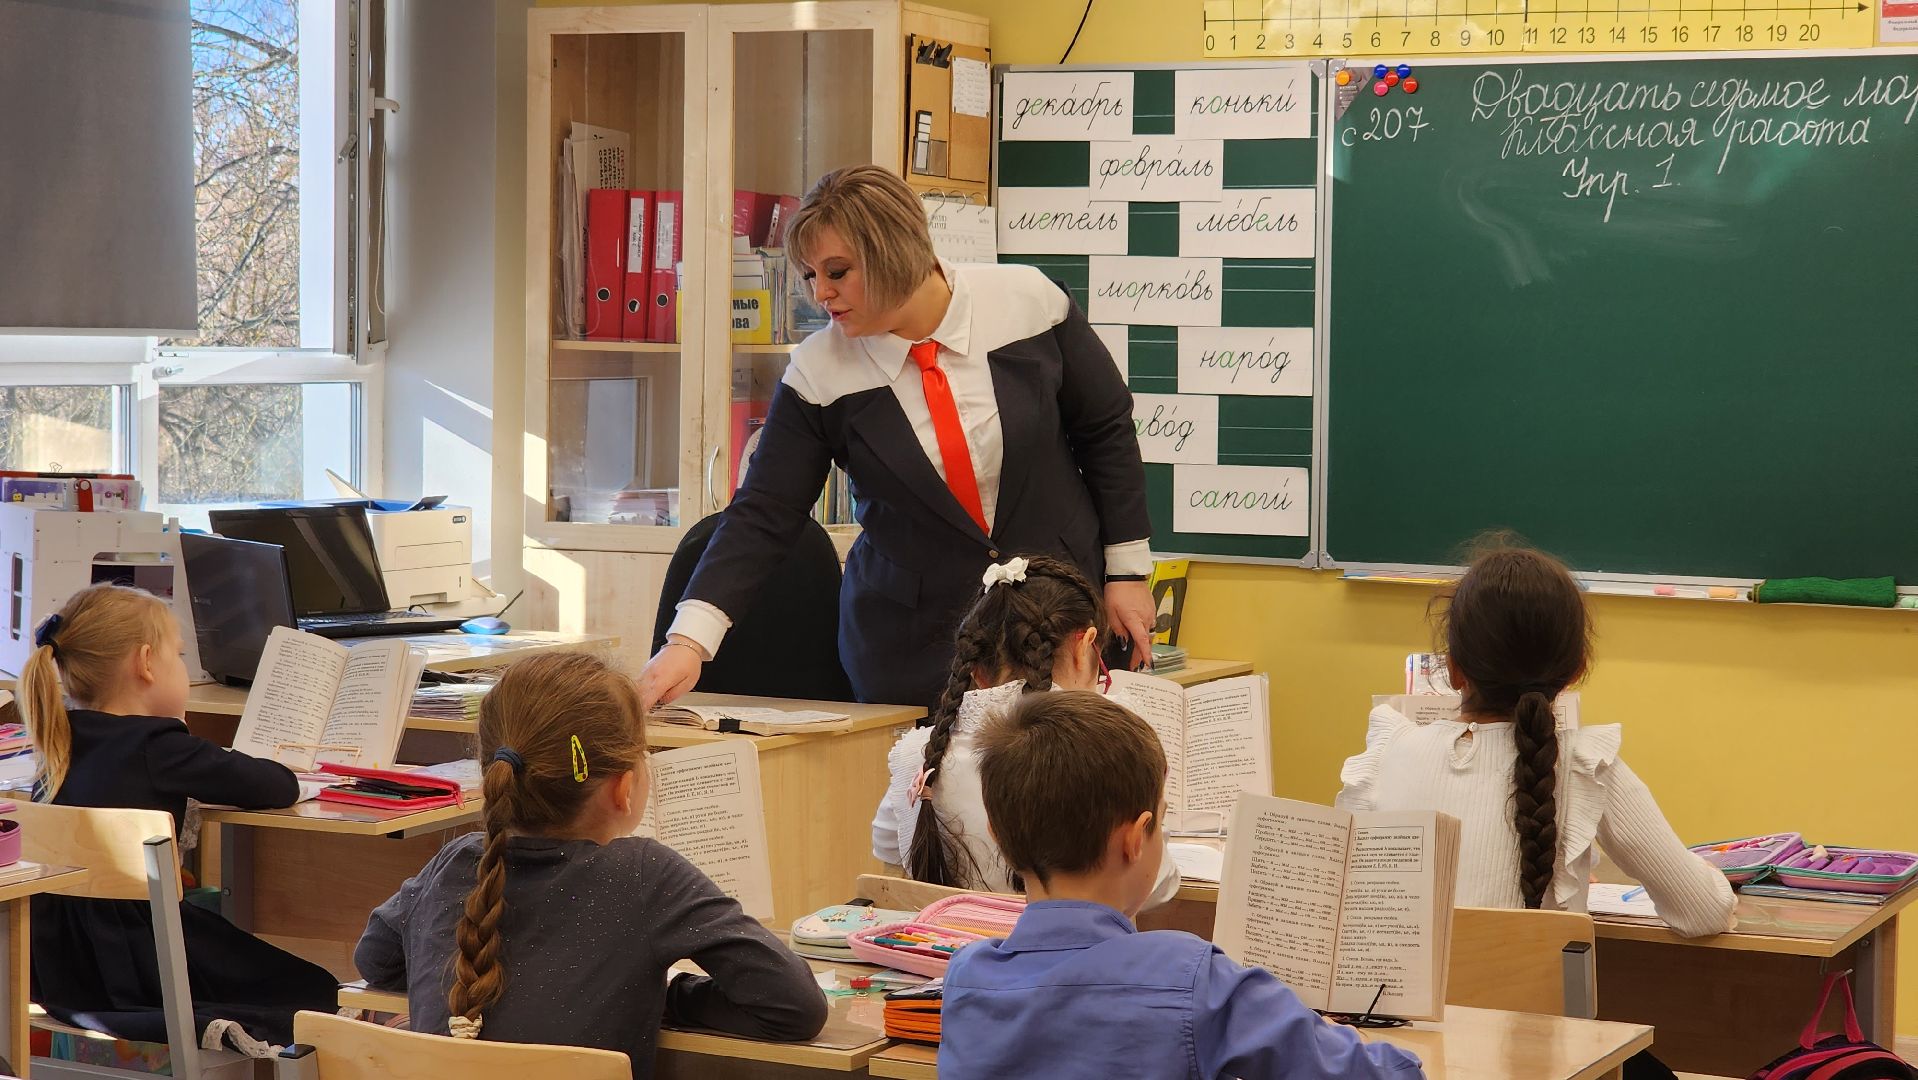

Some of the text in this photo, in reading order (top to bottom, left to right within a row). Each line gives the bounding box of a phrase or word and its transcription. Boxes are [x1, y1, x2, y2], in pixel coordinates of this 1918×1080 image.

[1205, 24, 1820, 51] 0 1 2 3 4 5 6 7 8 9 10 11 12 13 14 15 16 17 18 19 20
